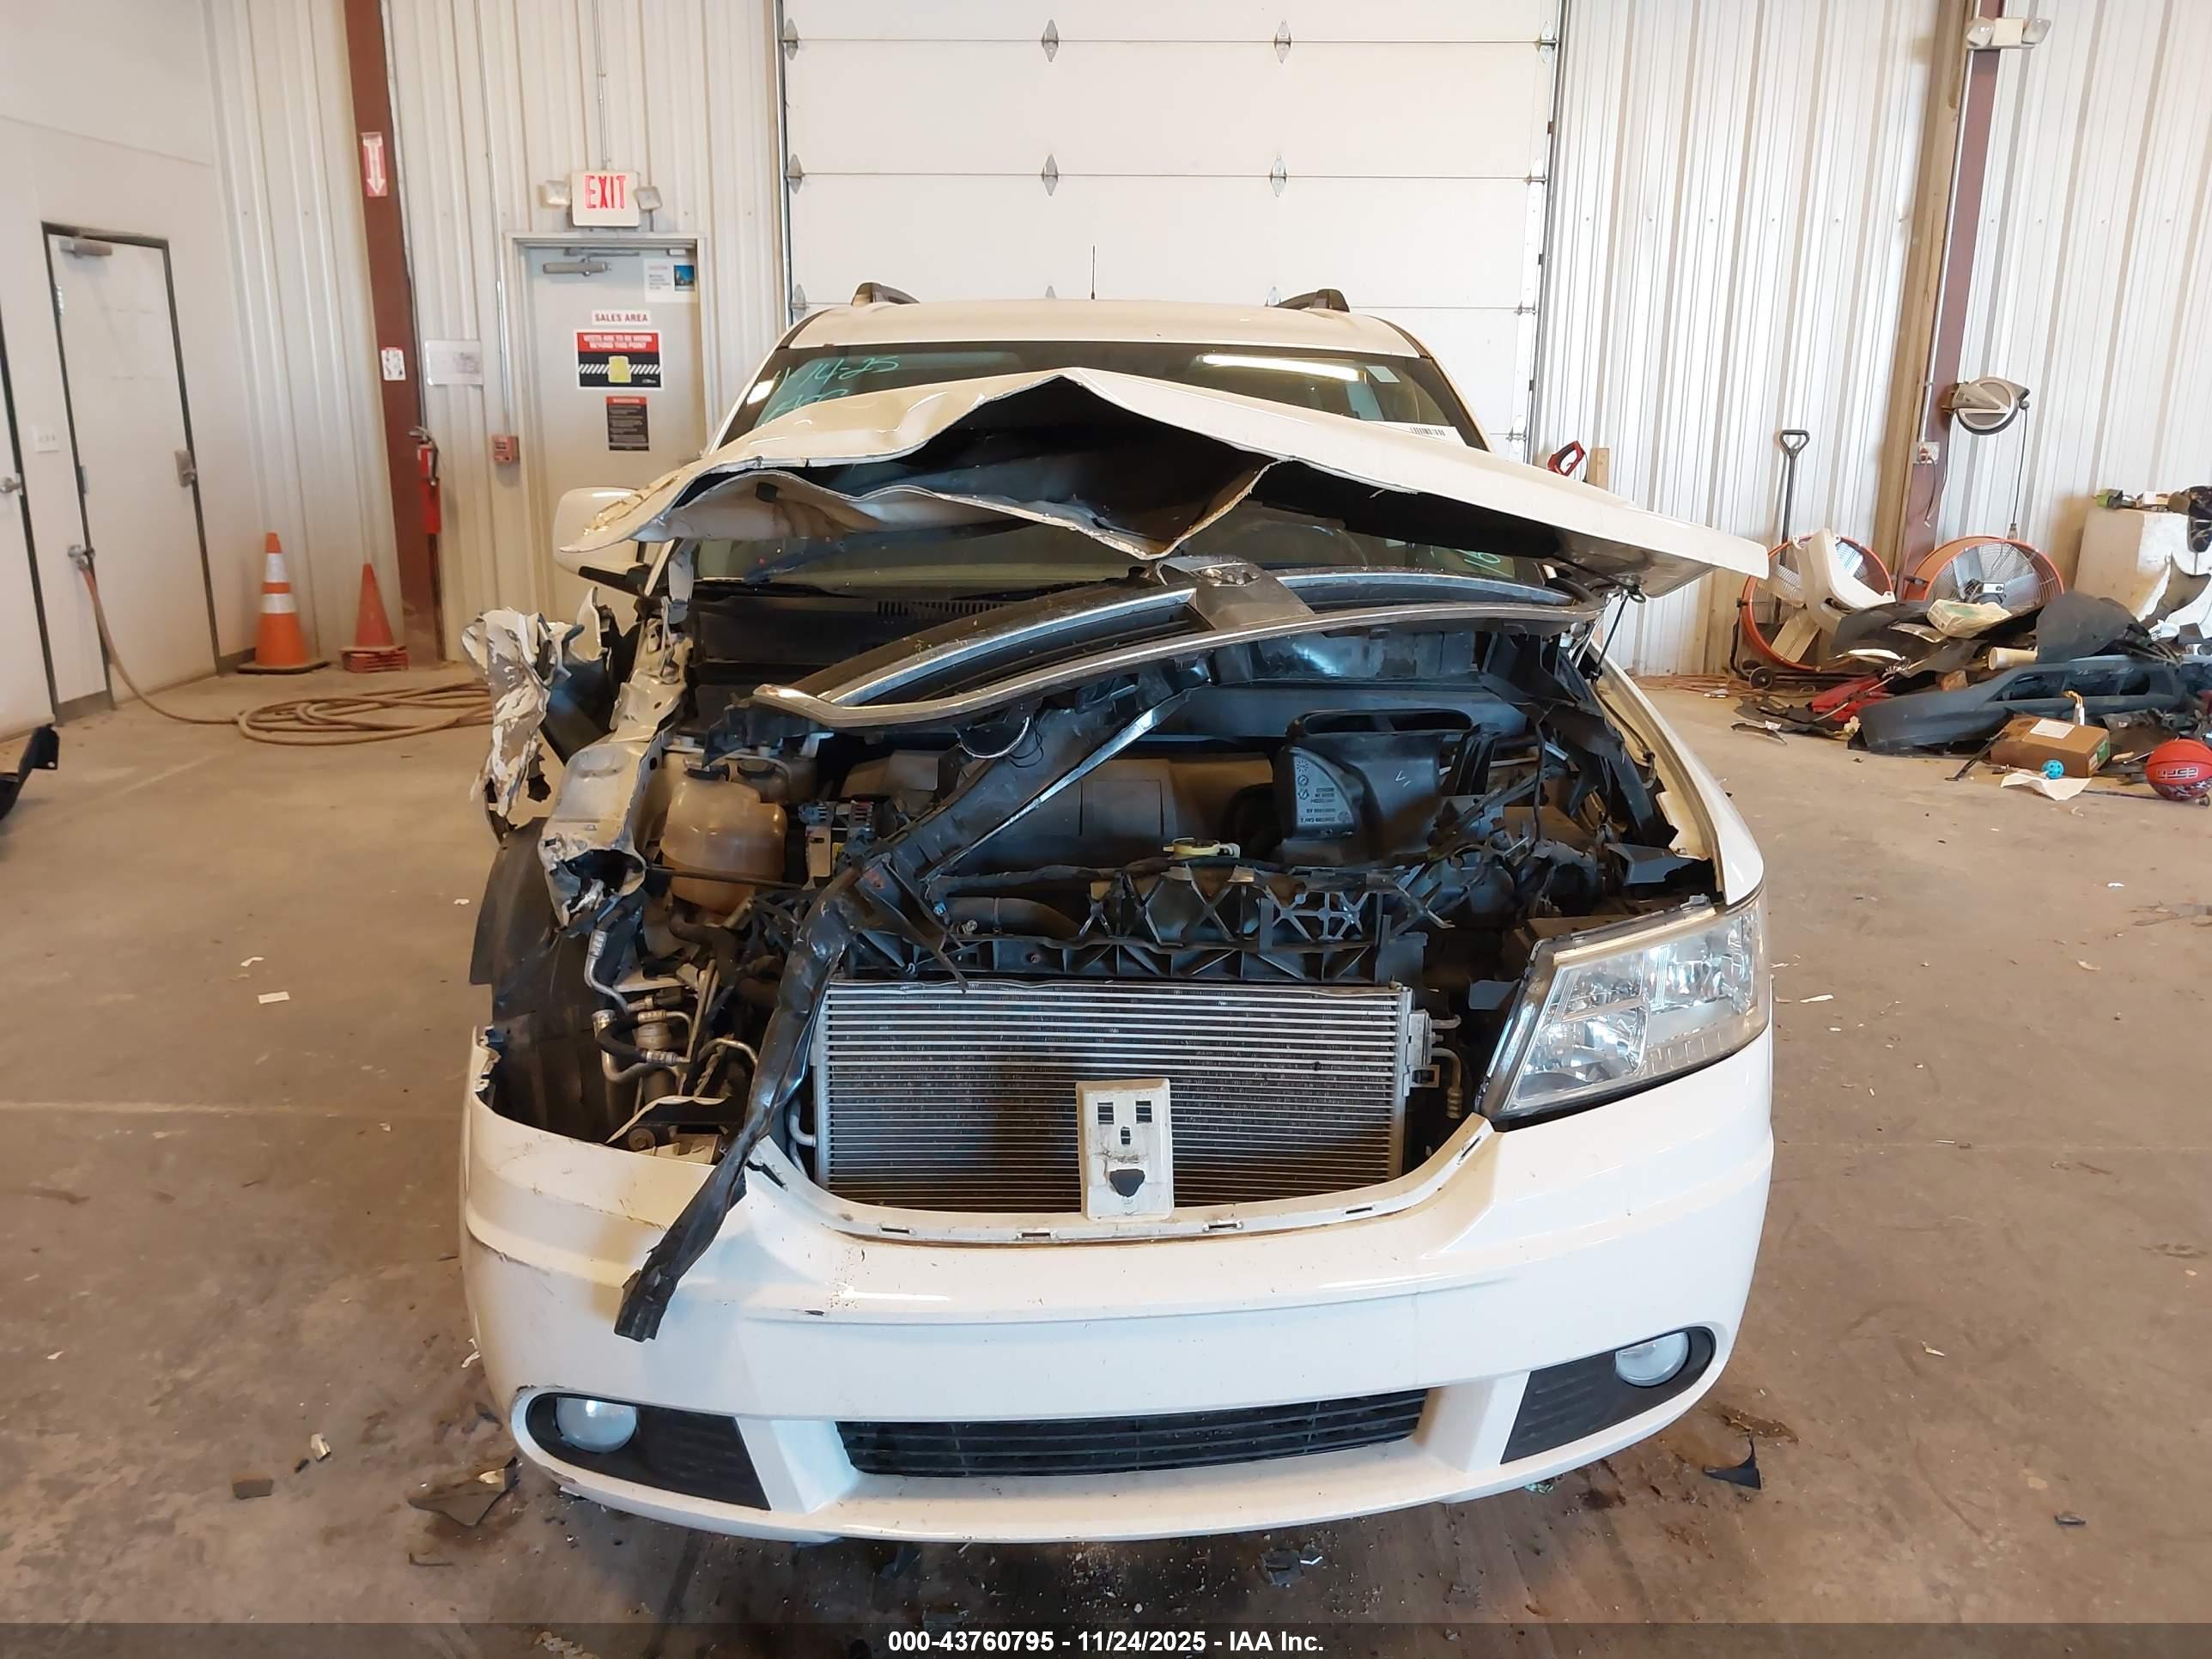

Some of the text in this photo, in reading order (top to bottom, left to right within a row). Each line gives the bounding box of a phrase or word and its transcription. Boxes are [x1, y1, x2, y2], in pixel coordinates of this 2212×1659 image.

[585, 174, 627, 209] EXIT
[595, 313, 648, 323] SALES AREA
[2157, 768, 2199, 780] ESPN
